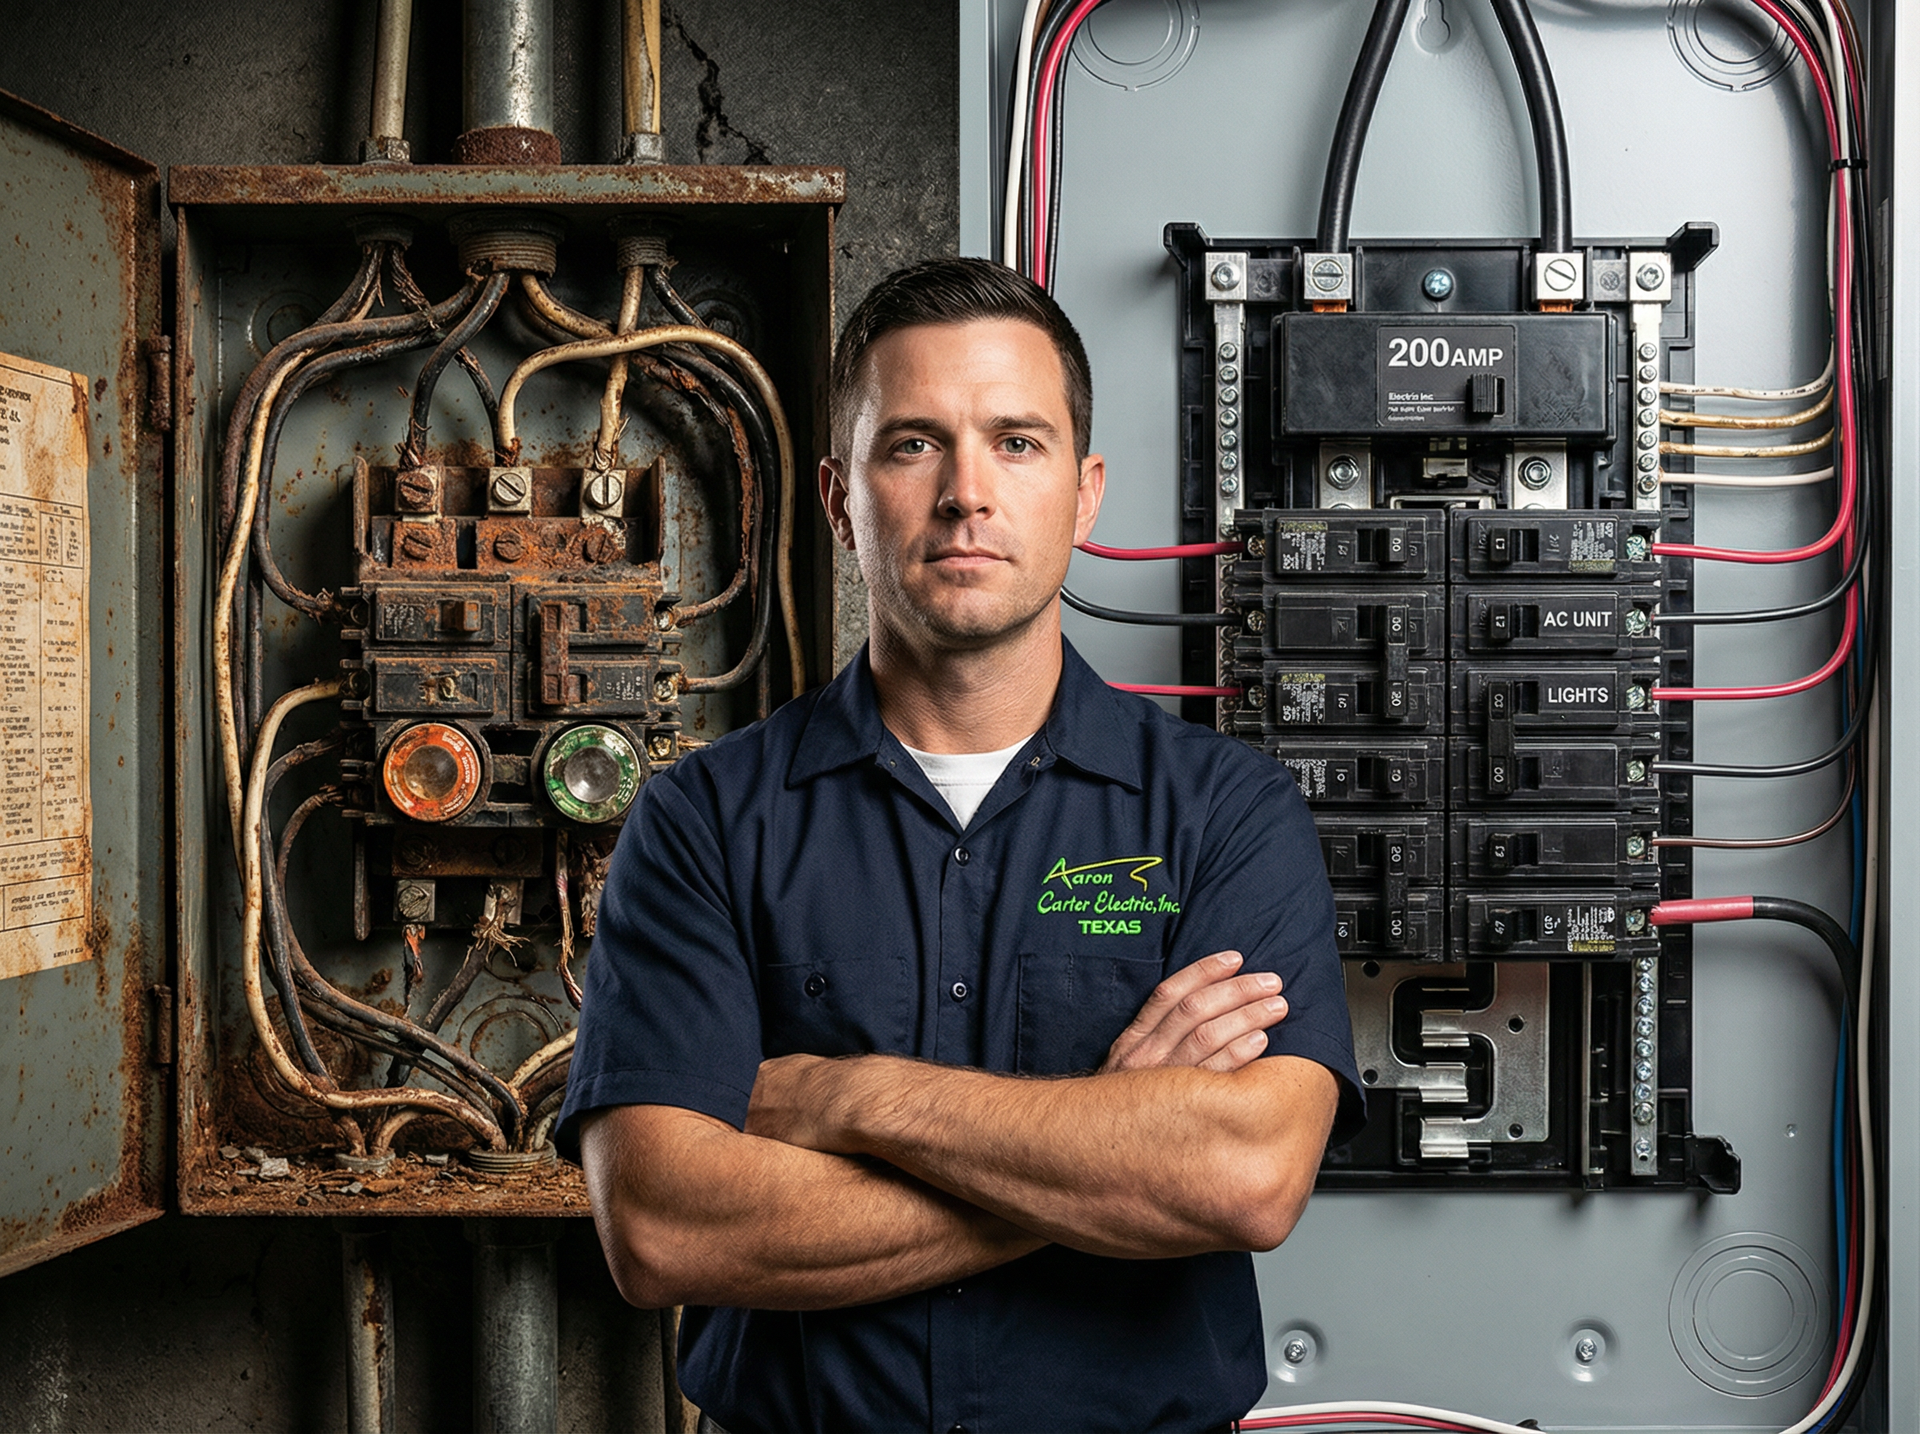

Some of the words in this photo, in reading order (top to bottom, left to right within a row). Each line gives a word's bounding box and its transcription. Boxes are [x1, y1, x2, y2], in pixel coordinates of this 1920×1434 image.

[1543, 610, 1569, 627] AC
[1573, 610, 1613, 627] UNIT
[1548, 687, 1609, 703] LIGHTS
[1042, 857, 1114, 890] Aaron
[1037, 889, 1091, 915] Carter
[1078, 919, 1142, 935] TEXAS
